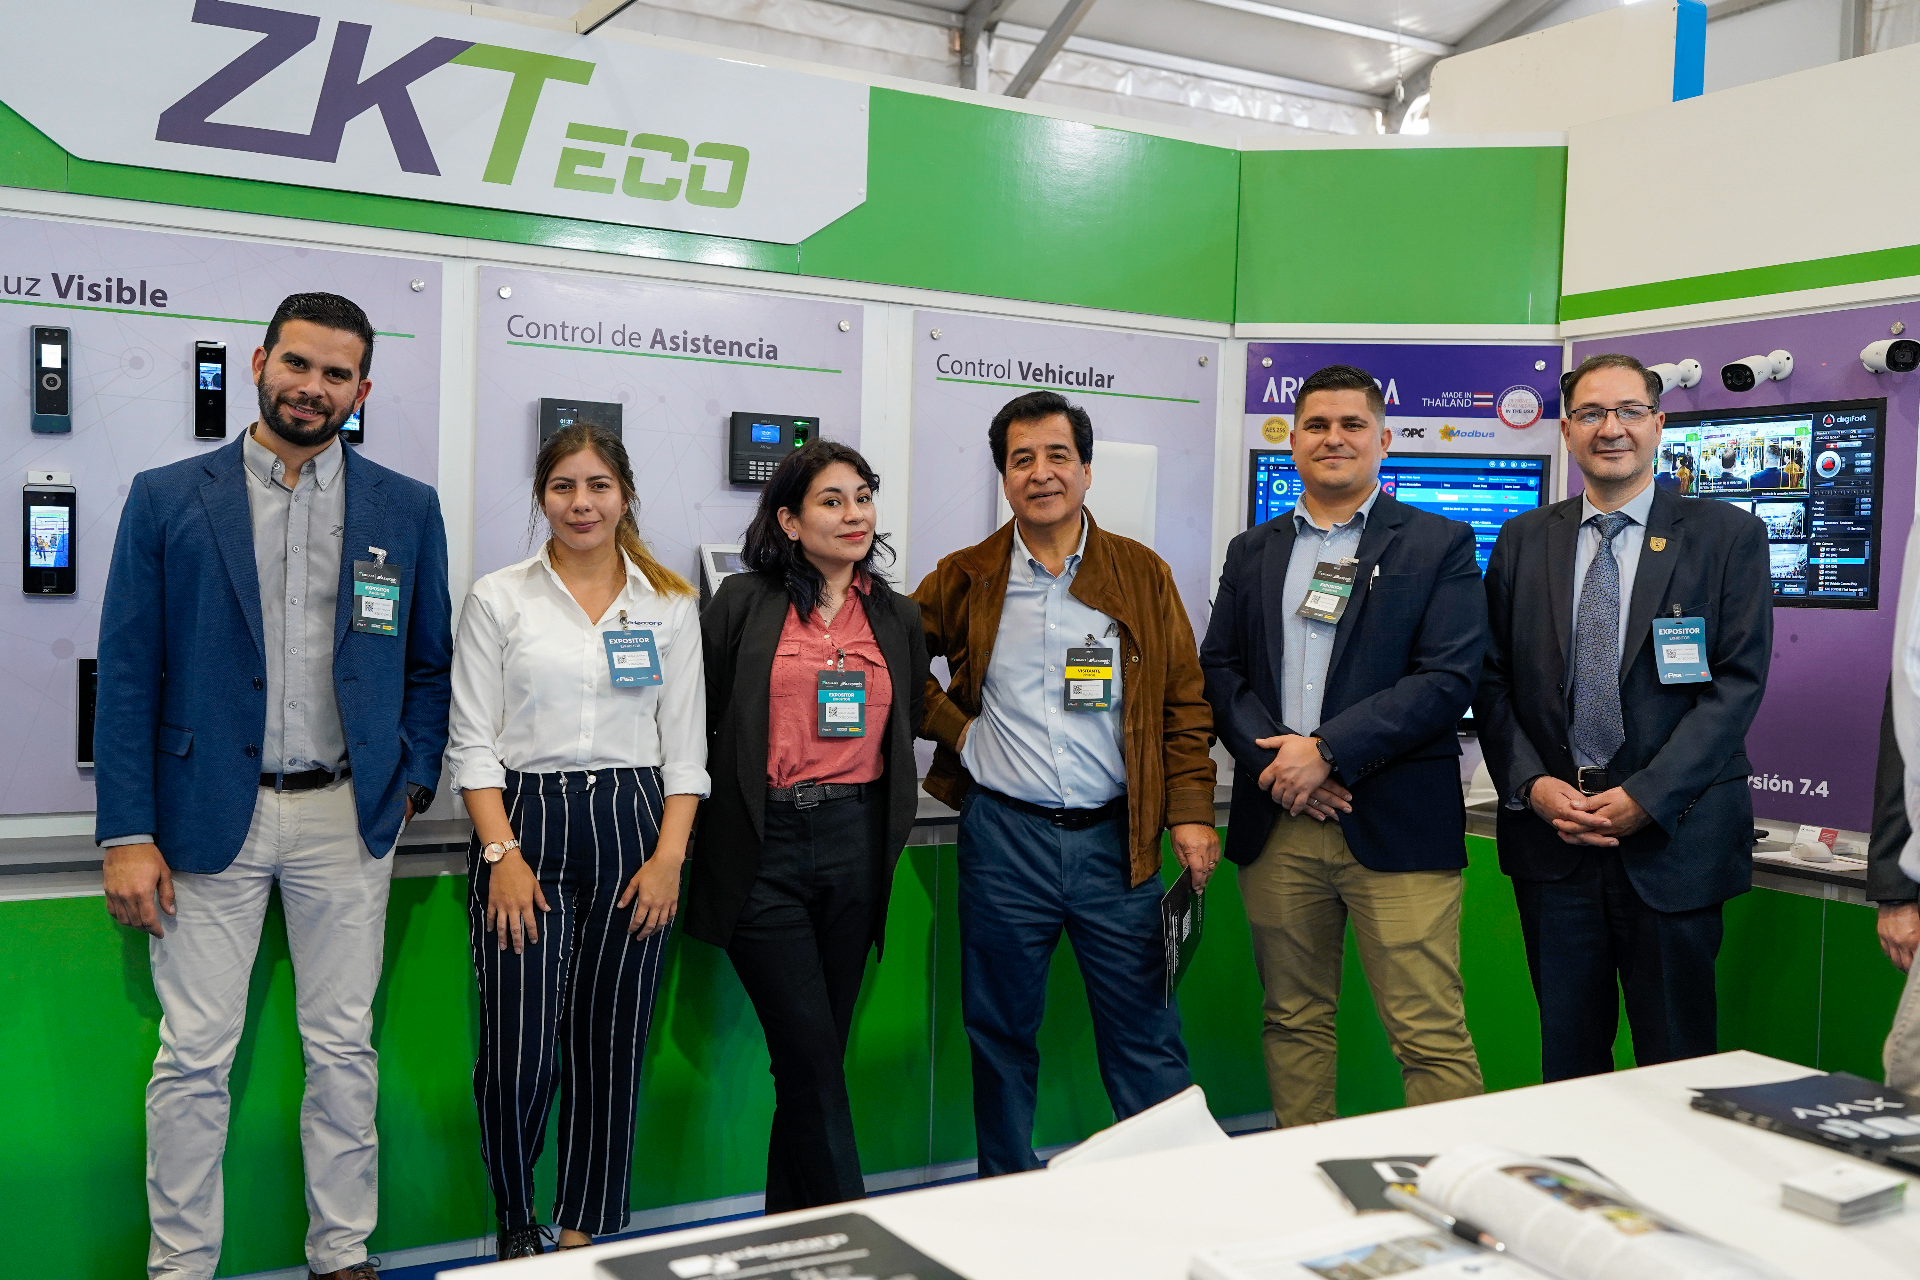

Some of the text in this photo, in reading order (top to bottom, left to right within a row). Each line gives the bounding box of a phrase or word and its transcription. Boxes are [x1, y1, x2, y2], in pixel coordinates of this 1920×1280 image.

[0, 272, 169, 308] uz Visible
[506, 314, 779, 361] Control de Asistencia
[936, 353, 1115, 389] Control Vehicular
[1441, 391, 1472, 399] MADE IN
[1422, 397, 1472, 408] THAILAND
[1401, 427, 1425, 438] OPC
[1447, 429, 1495, 438] Modbus
[1658, 627, 1701, 636] EXPOSITOR
[608, 637, 650, 645] EXPOSITOR
[1747, 773, 1830, 798] rsión 7.4
